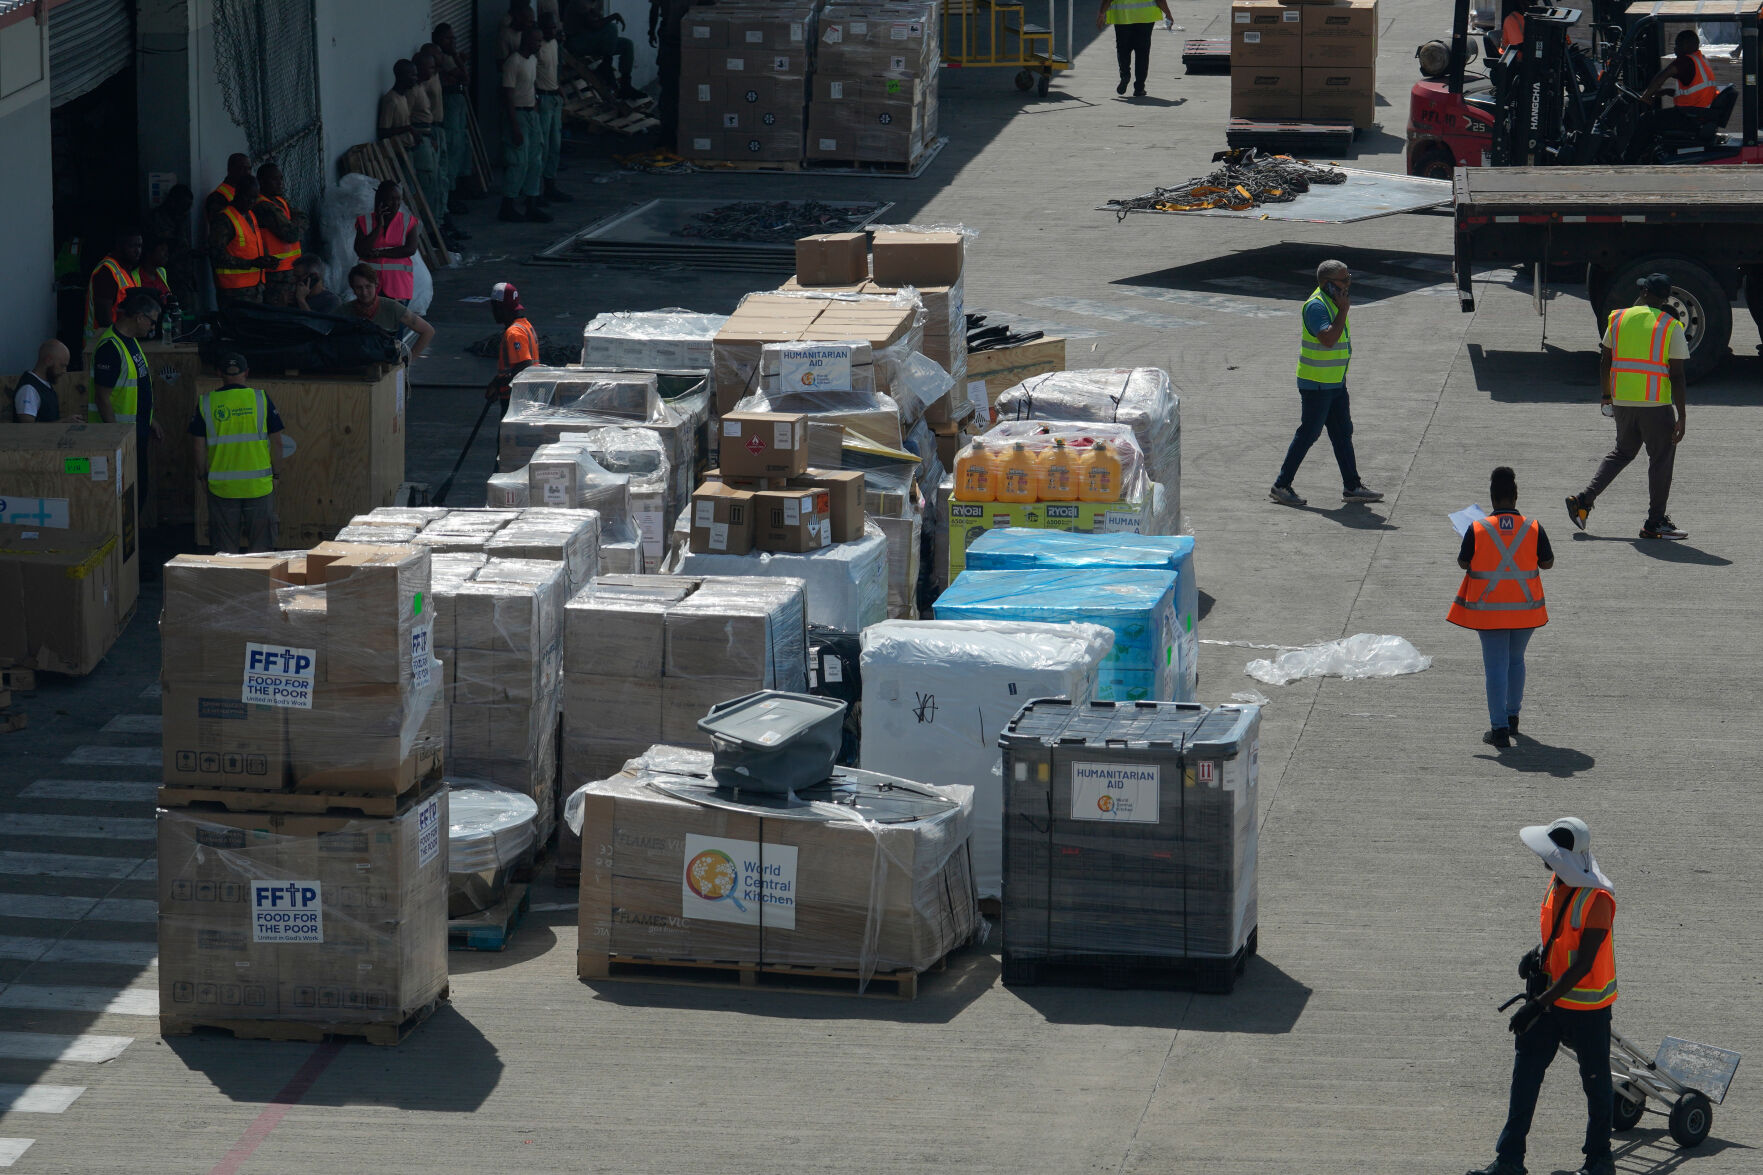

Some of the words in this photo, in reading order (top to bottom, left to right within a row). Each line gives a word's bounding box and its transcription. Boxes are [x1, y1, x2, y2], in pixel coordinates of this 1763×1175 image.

[1530, 82, 1541, 130] HANGCHA
[1472, 122, 1486, 132] 25
[783, 351, 848, 359] HUMANITARIAN
[809, 359, 823, 367] AID
[952, 506, 982, 516] RYOBI
[1047, 507, 1078, 517] RYOBI
[1501, 518, 1512, 528] M
[248, 675, 282, 687] FOOD
[284, 679, 309, 690] FOR
[248, 685, 270, 696] THE
[273, 687, 308, 699] POOR
[246, 696, 266, 704] United
[1077, 768, 1154, 781] HUMANITARIAN
[1107, 780, 1124, 789] AID
[744, 860, 781, 876] World
[744, 875, 791, 892] Central
[744, 890, 793, 906] Kitchen
[257, 913, 291, 922] FOOD
[293, 913, 318, 923] FOR
[620, 911, 667, 926] FLAMES
[258, 924, 281, 933] THE
[284, 924, 318, 934] POOR
